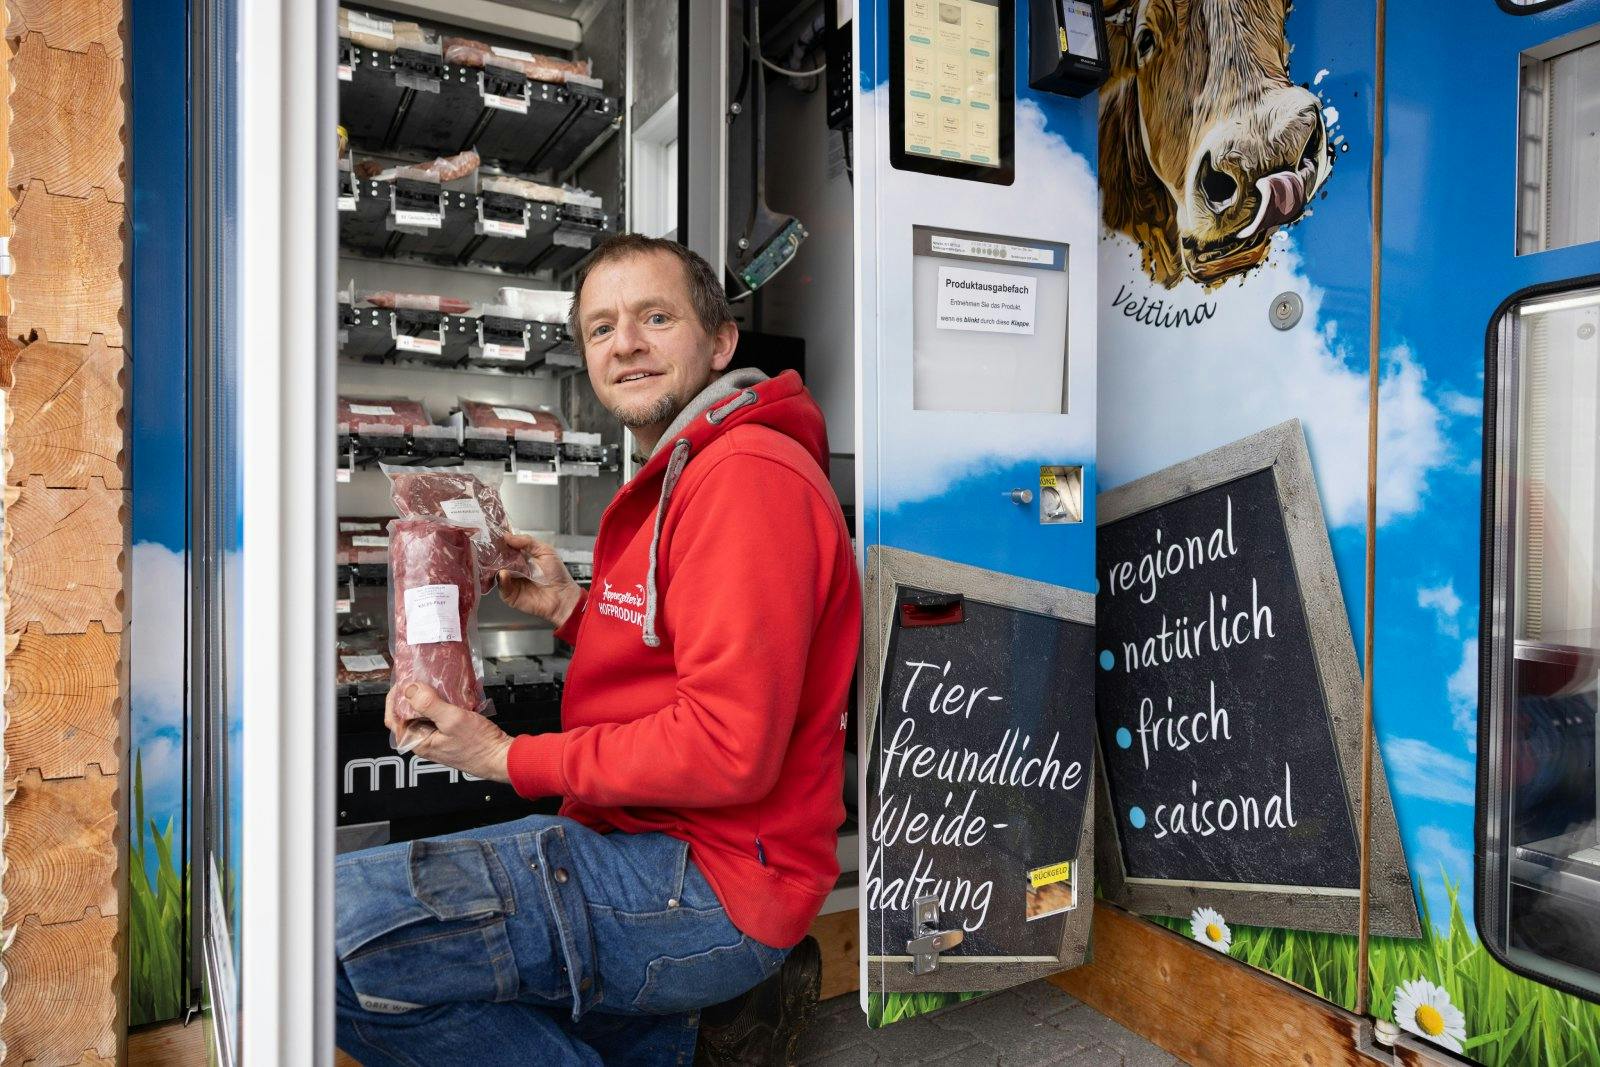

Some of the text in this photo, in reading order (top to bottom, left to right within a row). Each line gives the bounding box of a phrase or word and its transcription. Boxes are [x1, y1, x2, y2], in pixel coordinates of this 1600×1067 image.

[945, 278, 1029, 295] Produktausgabefach
[950, 298, 980, 308] Entnehmen
[1112, 284, 1217, 328] Veltlina
[963, 316, 980, 324] blinkt
[1109, 494, 1238, 604] regional
[1122, 577, 1276, 673] natürlich
[901, 660, 1004, 718] Tier-
[1136, 680, 1232, 770] frisch
[344, 755, 486, 794] MA
[878, 718, 1083, 796] freundliche
[872, 790, 1008, 847] Weide-
[1153, 762, 1298, 839] saisonal
[866, 846, 994, 932] haltung
[1034, 866, 1068, 881] RÜCKGELD
